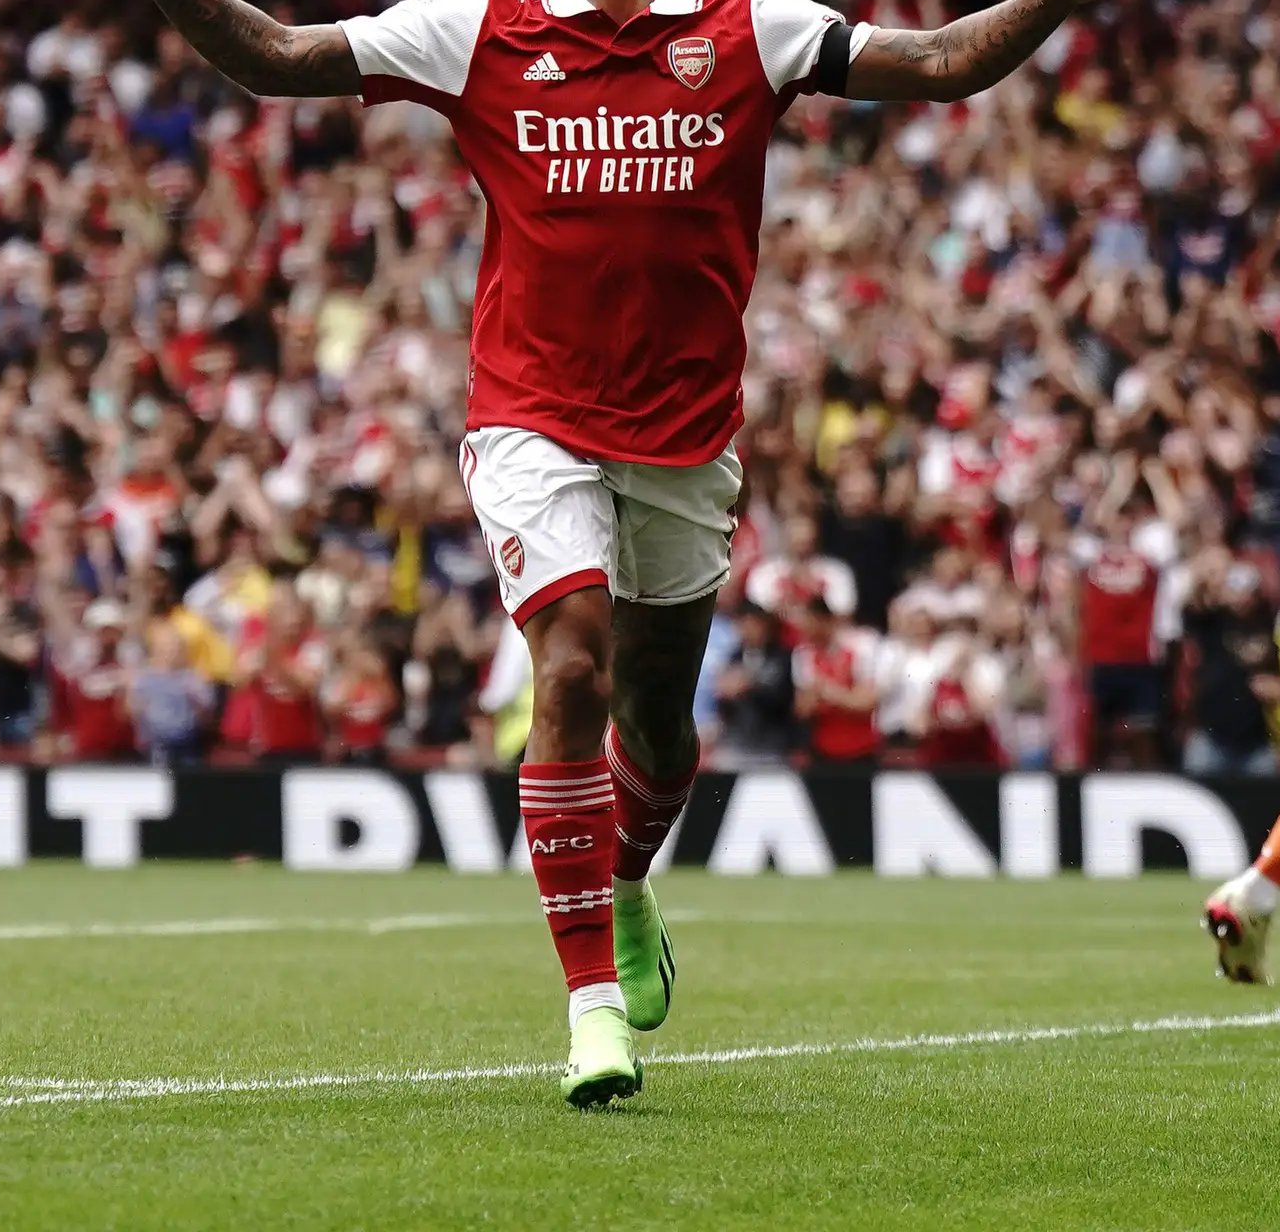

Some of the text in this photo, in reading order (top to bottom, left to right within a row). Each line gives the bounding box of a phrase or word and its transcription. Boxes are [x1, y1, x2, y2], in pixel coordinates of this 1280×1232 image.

[674, 44, 708, 56] Arsenal
[523, 69, 566, 81] adidas
[513, 106, 725, 152] Emirates
[546, 155, 694, 194] FLY BETTER
[531, 835, 593, 855] AFC
